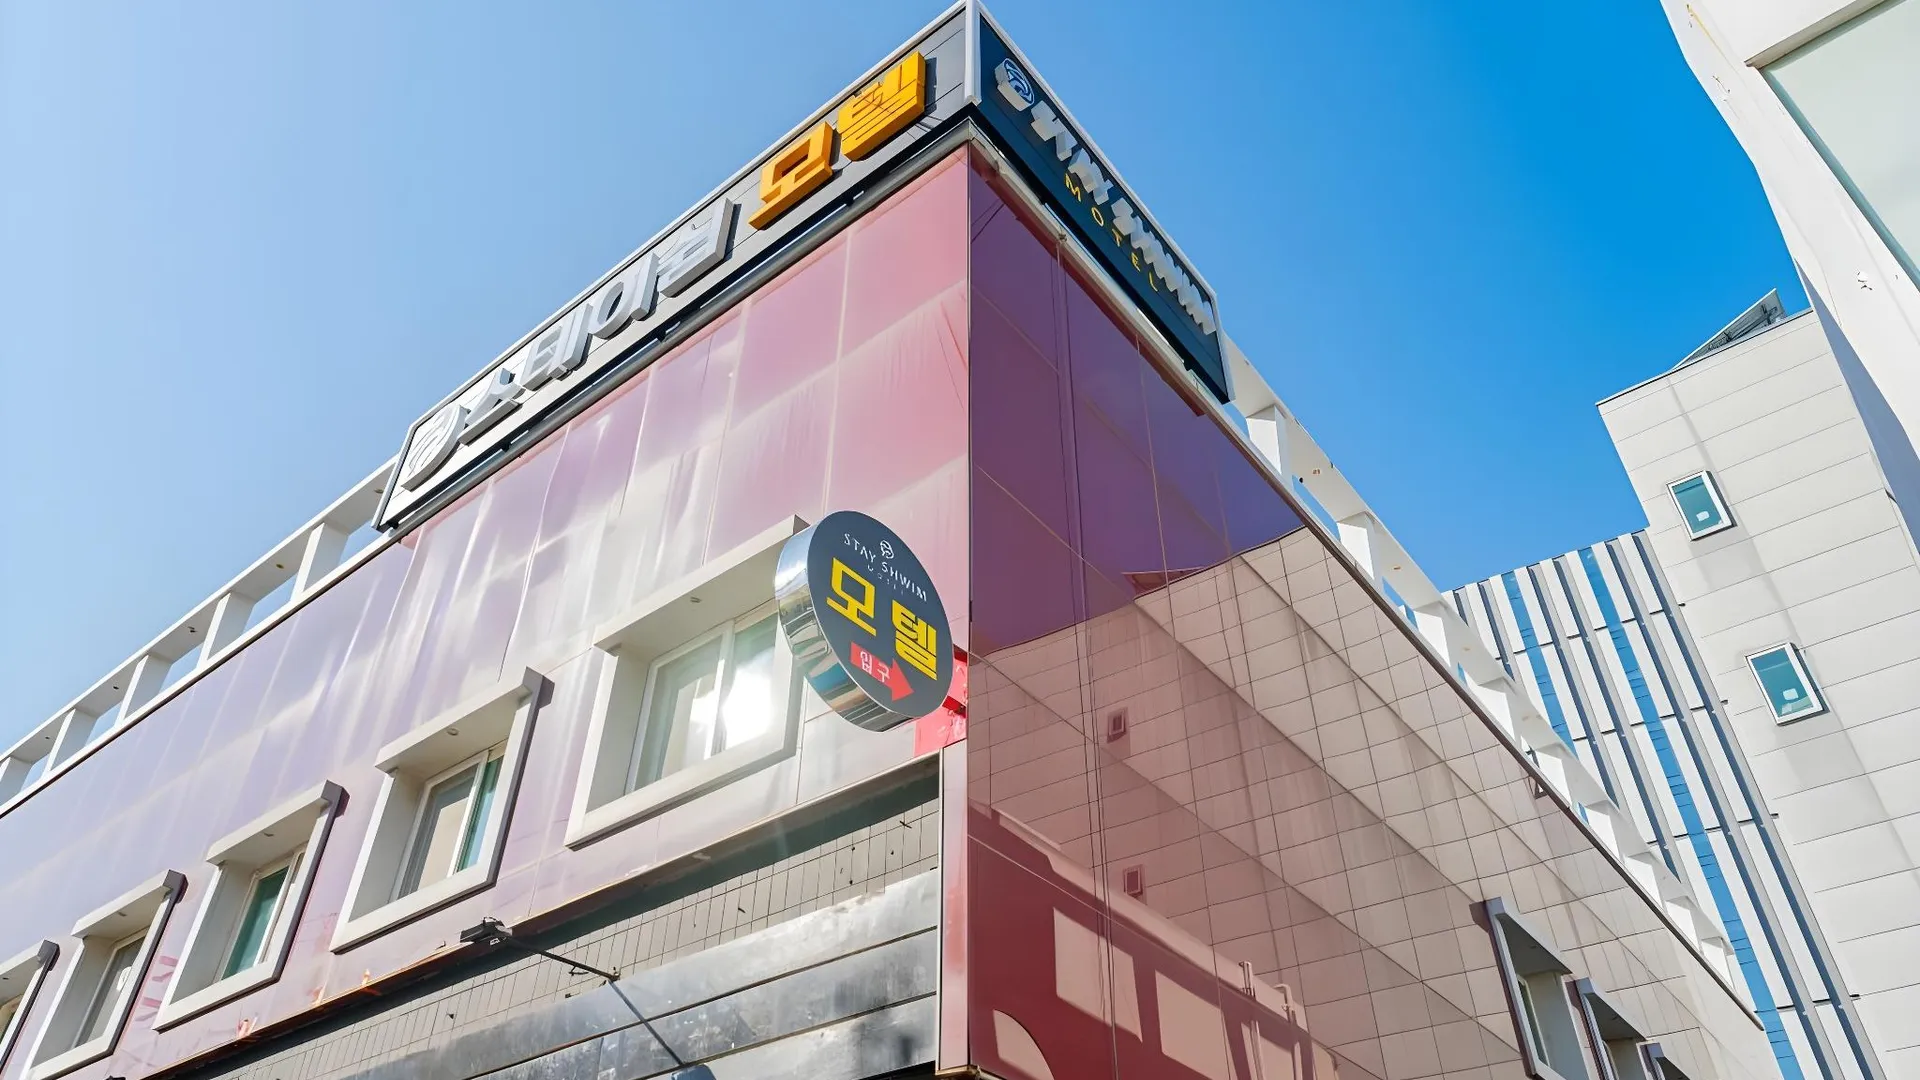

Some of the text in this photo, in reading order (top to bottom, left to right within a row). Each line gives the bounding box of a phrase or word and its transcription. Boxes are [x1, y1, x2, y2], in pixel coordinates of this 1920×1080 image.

[748, 51, 926, 230] 모텔
[844, 533, 876, 563] STAY
[881, 561, 927, 602] SHWIM
[826, 556, 938, 681] 모텔
[860, 650, 890, 683] 입구
